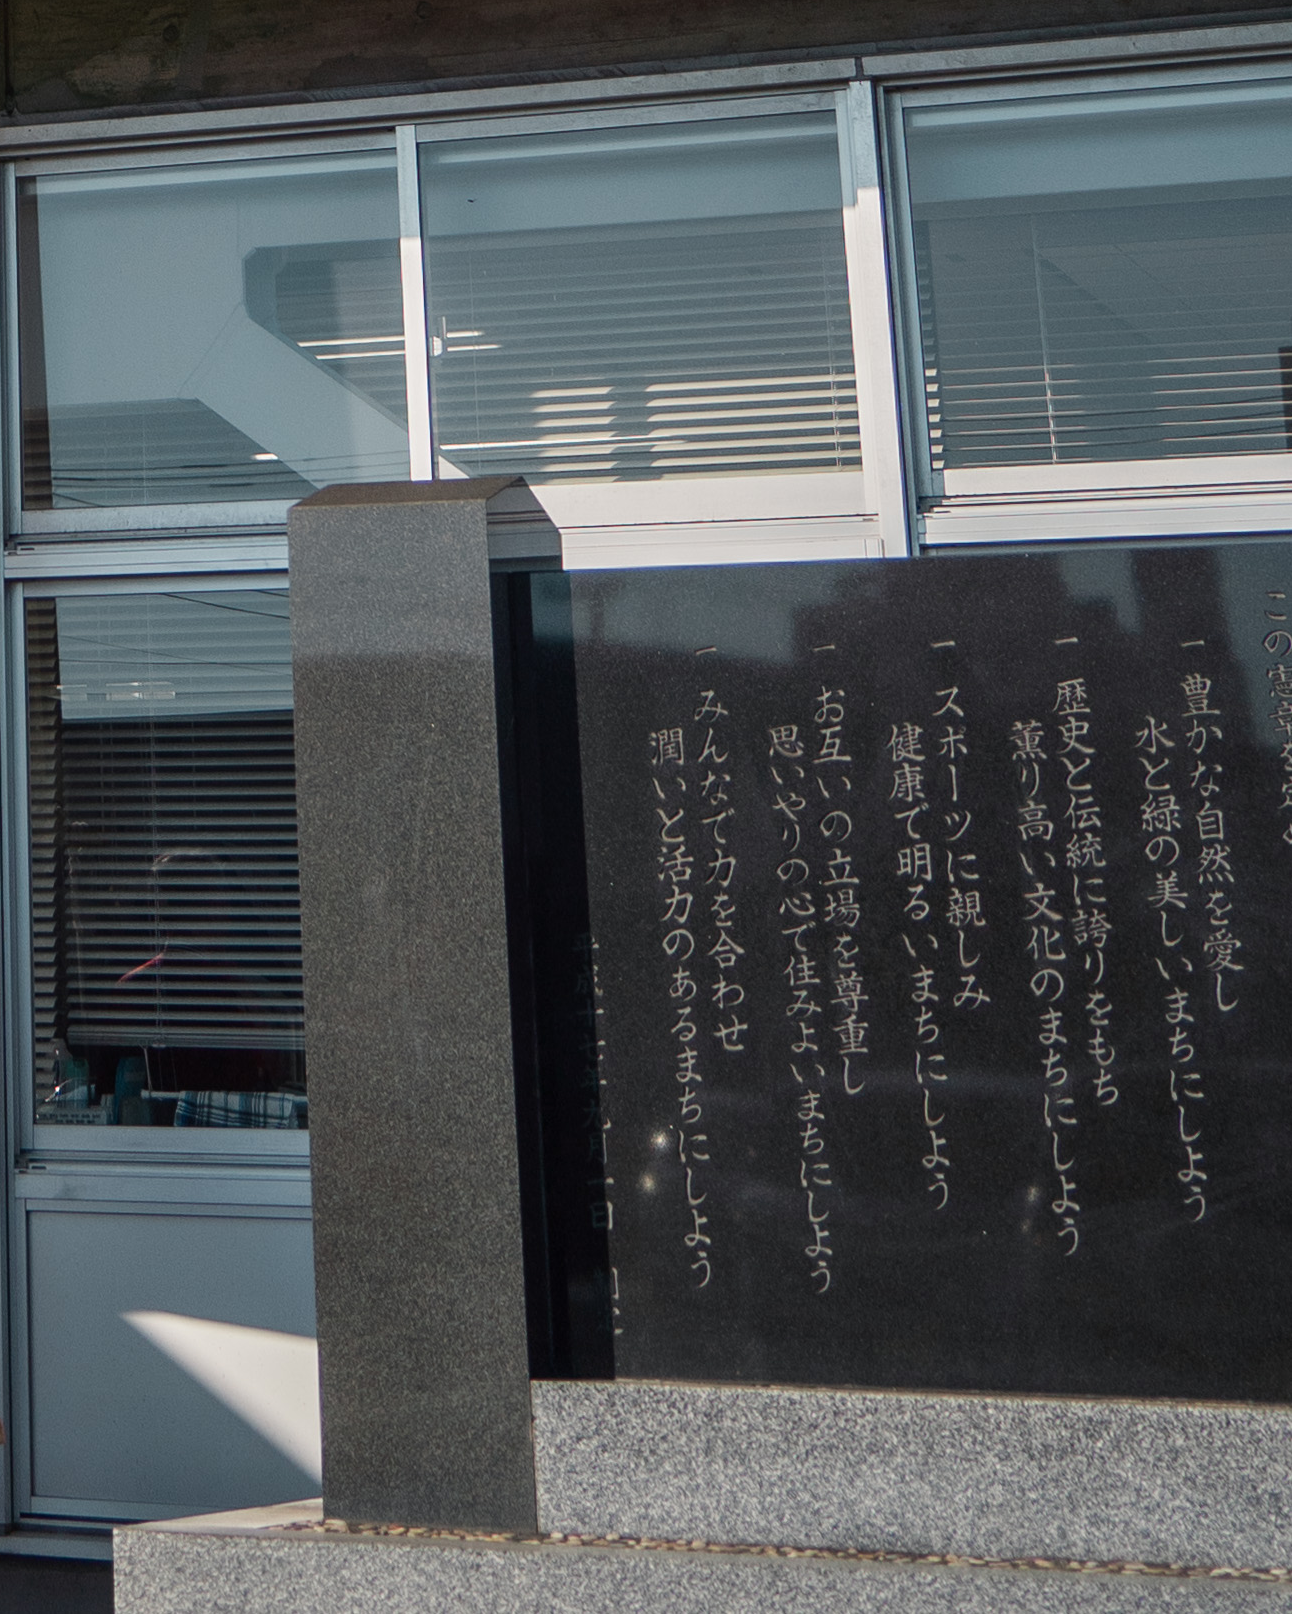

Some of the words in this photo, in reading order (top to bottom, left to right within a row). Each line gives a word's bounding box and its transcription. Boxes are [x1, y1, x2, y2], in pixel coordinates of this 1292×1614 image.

[647, 727, 712, 1289] 潤いと活力のあるまちにしよう
[693, 690, 749, 1052] みんなで力を合わせ
[766, 723, 834, 1294] 思いやりの心で住みよいまちにしよう
[811, 685, 870, 1096] お互いの立場を尊重し
[885, 723, 951, 1211] 健康で明るいまちにしよう
[931, 685, 992, 1010] スポーツに親しみ
[1008, 719, 1081, 1256] 薫り高い文化のまちにしよう
[1052, 677, 1119, 1106] 歴史と伝統に誇りをもち
[1134, 715, 1208, 1223] 水と緑の美しいまちにしよう
[1179, 672, 1244, 1013] 豊かな自然を愛し
